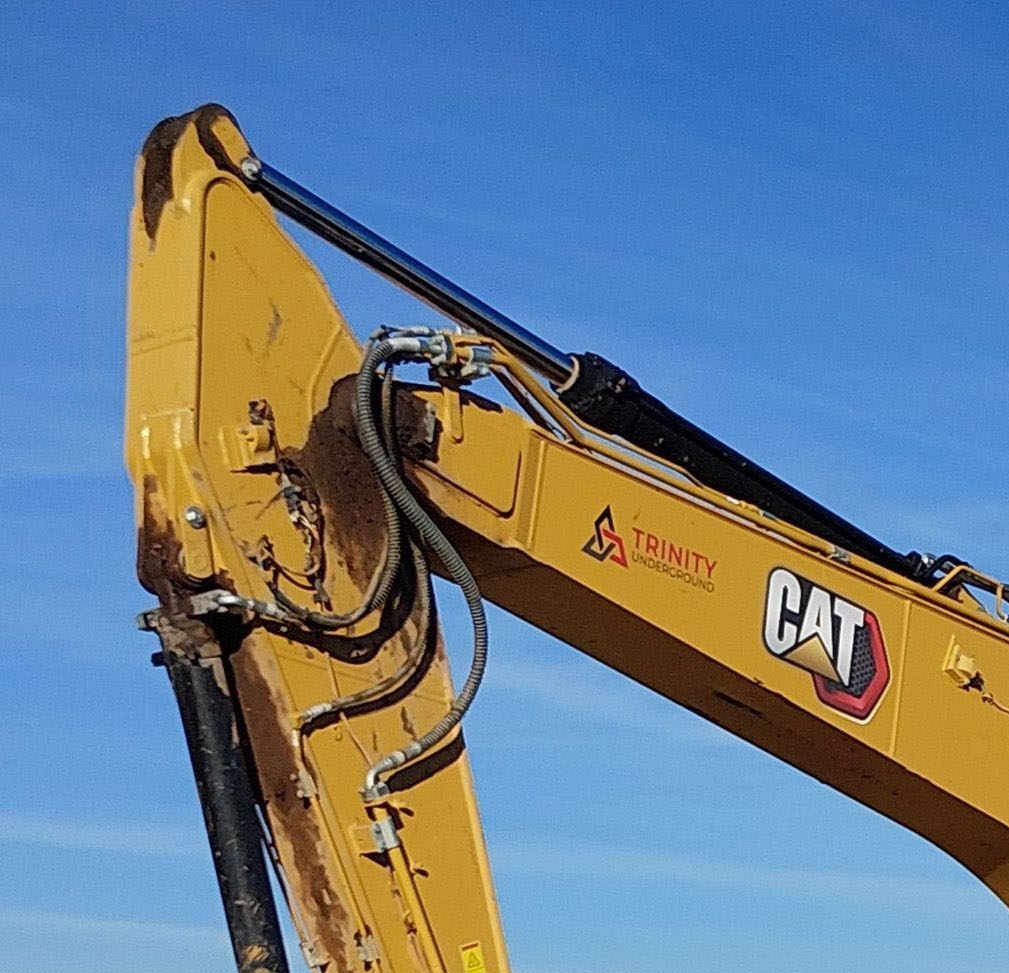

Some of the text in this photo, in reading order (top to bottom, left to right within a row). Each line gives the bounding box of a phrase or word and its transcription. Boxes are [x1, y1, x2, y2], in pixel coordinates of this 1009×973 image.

[631, 551, 715, 593] UNDERGROUND
[632, 527, 717, 578] TRINITY
[765, 567, 865, 687] CAT
